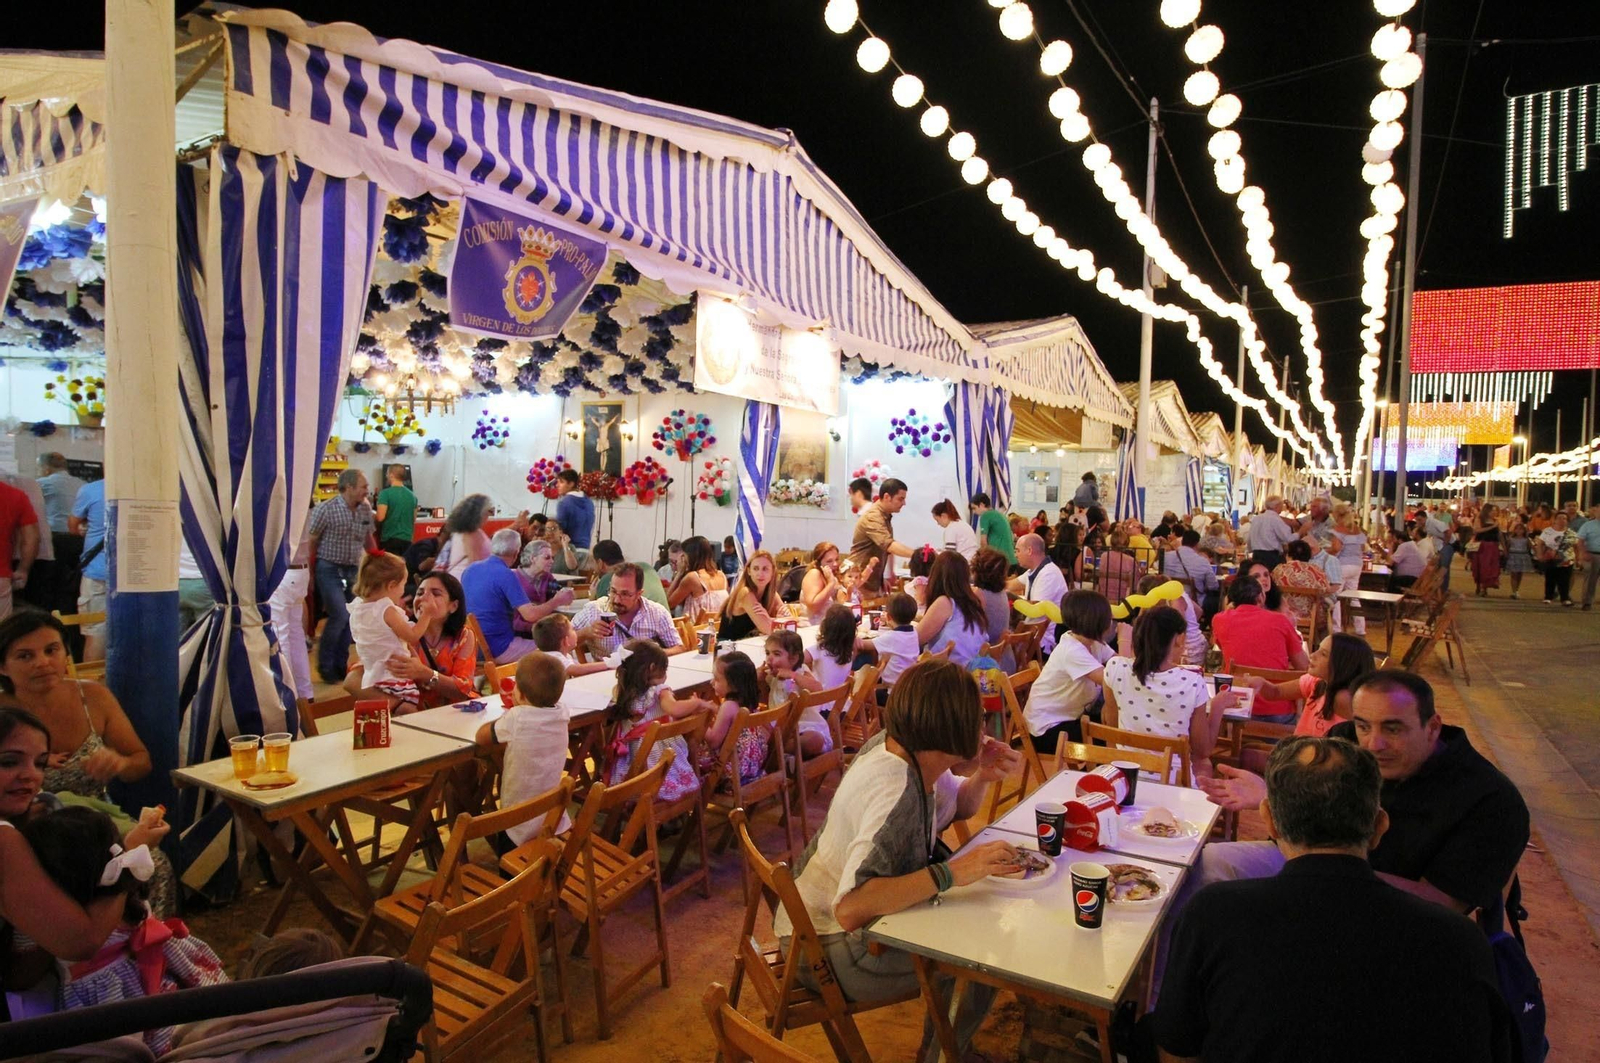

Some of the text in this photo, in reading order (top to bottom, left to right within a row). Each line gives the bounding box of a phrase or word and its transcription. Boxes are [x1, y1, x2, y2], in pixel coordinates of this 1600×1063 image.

[464, 216, 513, 248] COMISIÓN
[462, 312, 500, 330] VIRGEN
[502, 322, 515, 332] DE
[516, 325, 532, 334] LOS
[750, 363, 775, 379] Nuestra
